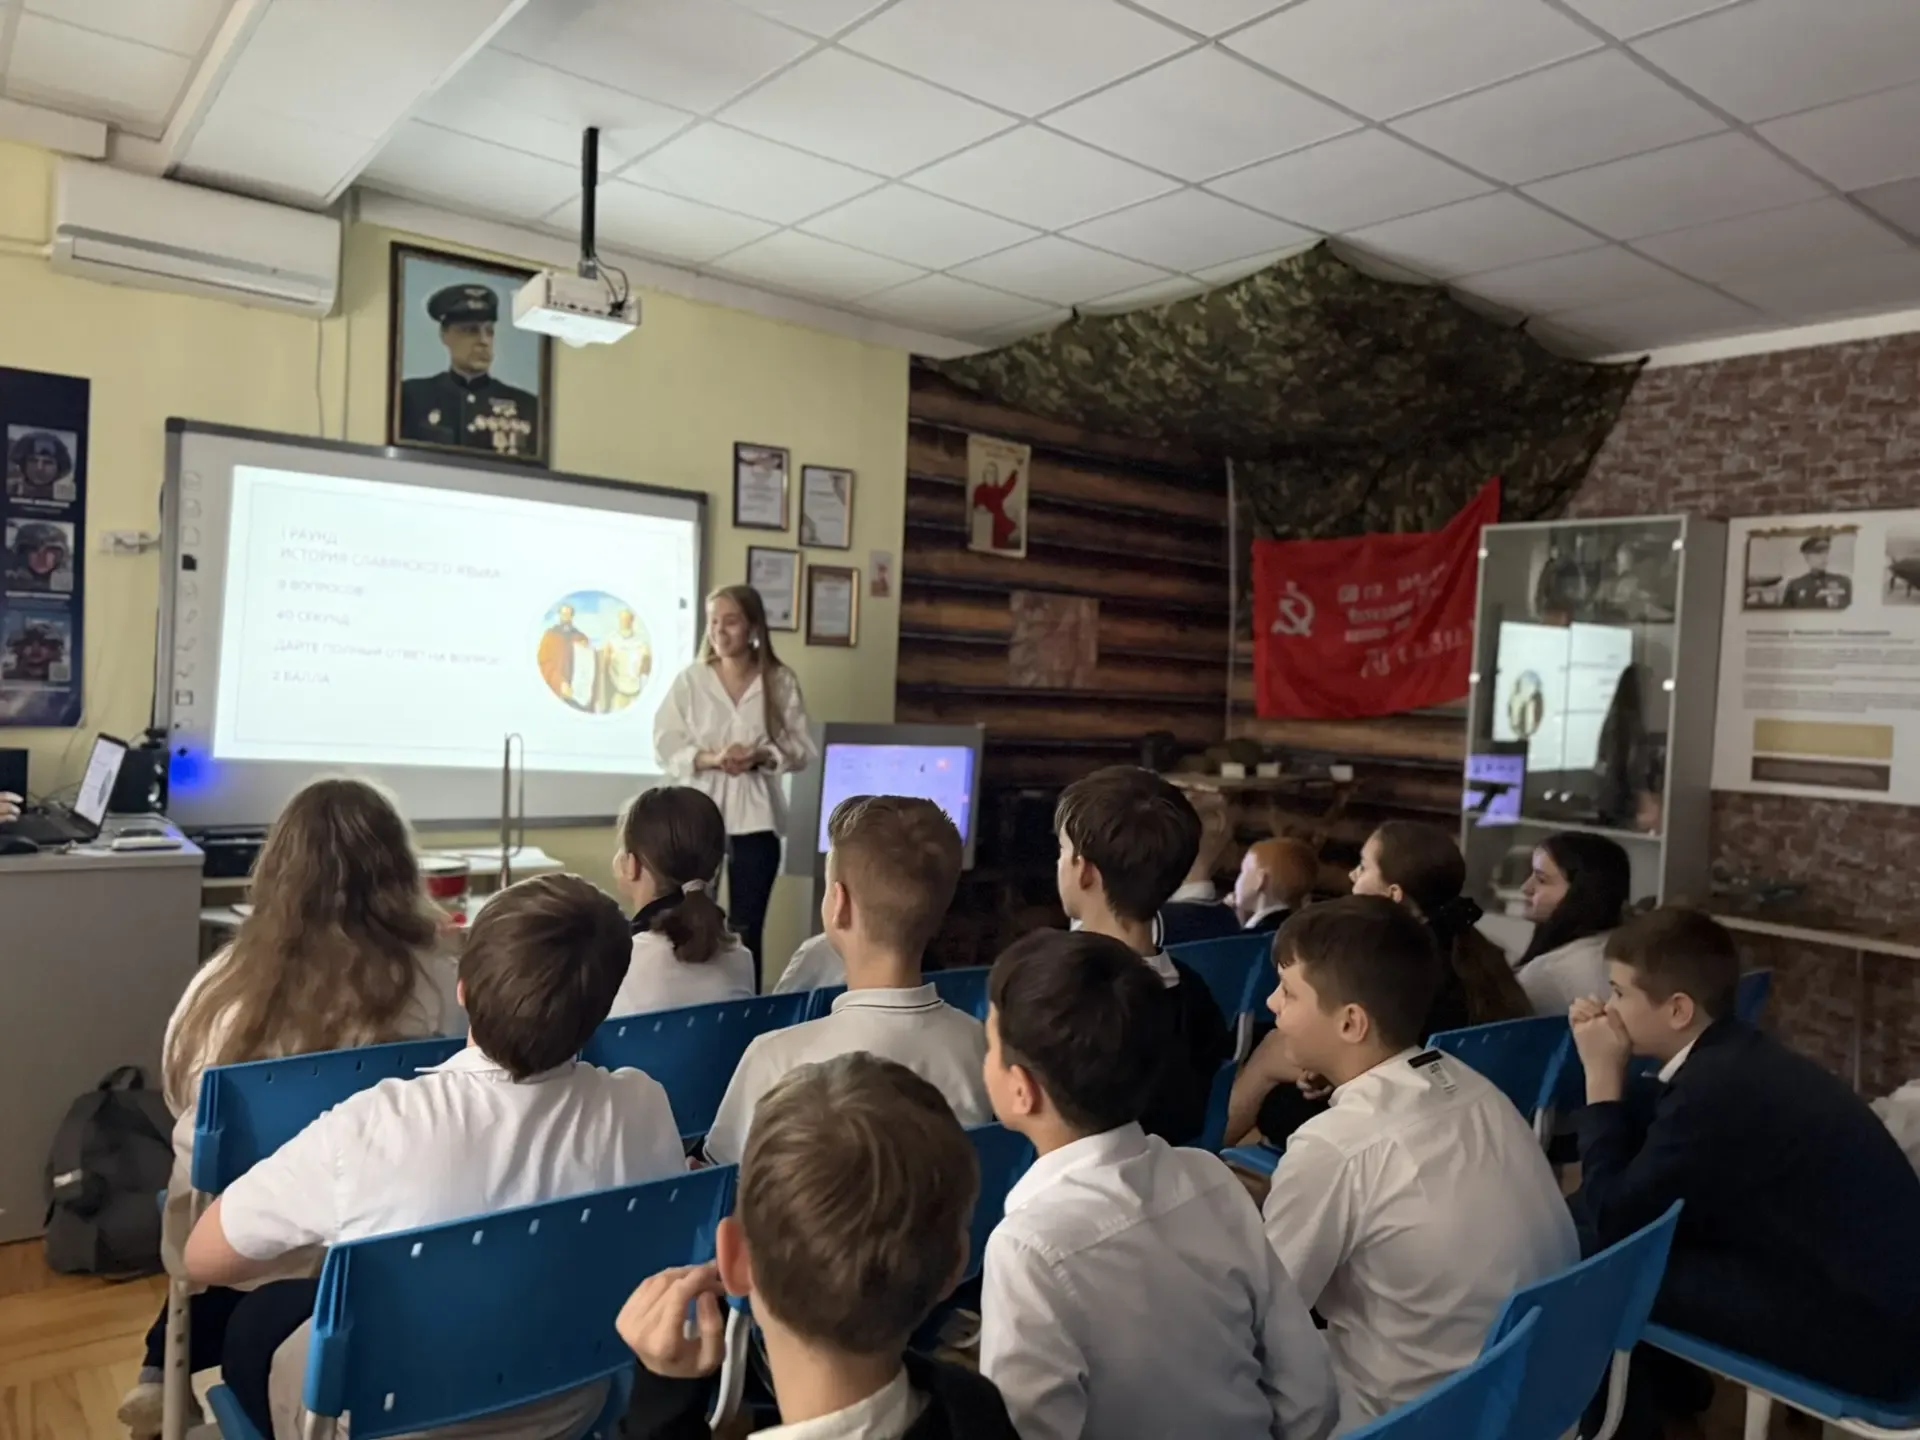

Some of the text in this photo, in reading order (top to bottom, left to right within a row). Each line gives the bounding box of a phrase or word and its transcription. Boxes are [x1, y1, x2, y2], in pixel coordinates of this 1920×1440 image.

[289, 528, 338, 545] РАУНД
[280, 547, 348, 564] ИСТОРИЯ
[297, 611, 350, 627] СЕКУНД
[283, 670, 330, 684] БАЛЛА
